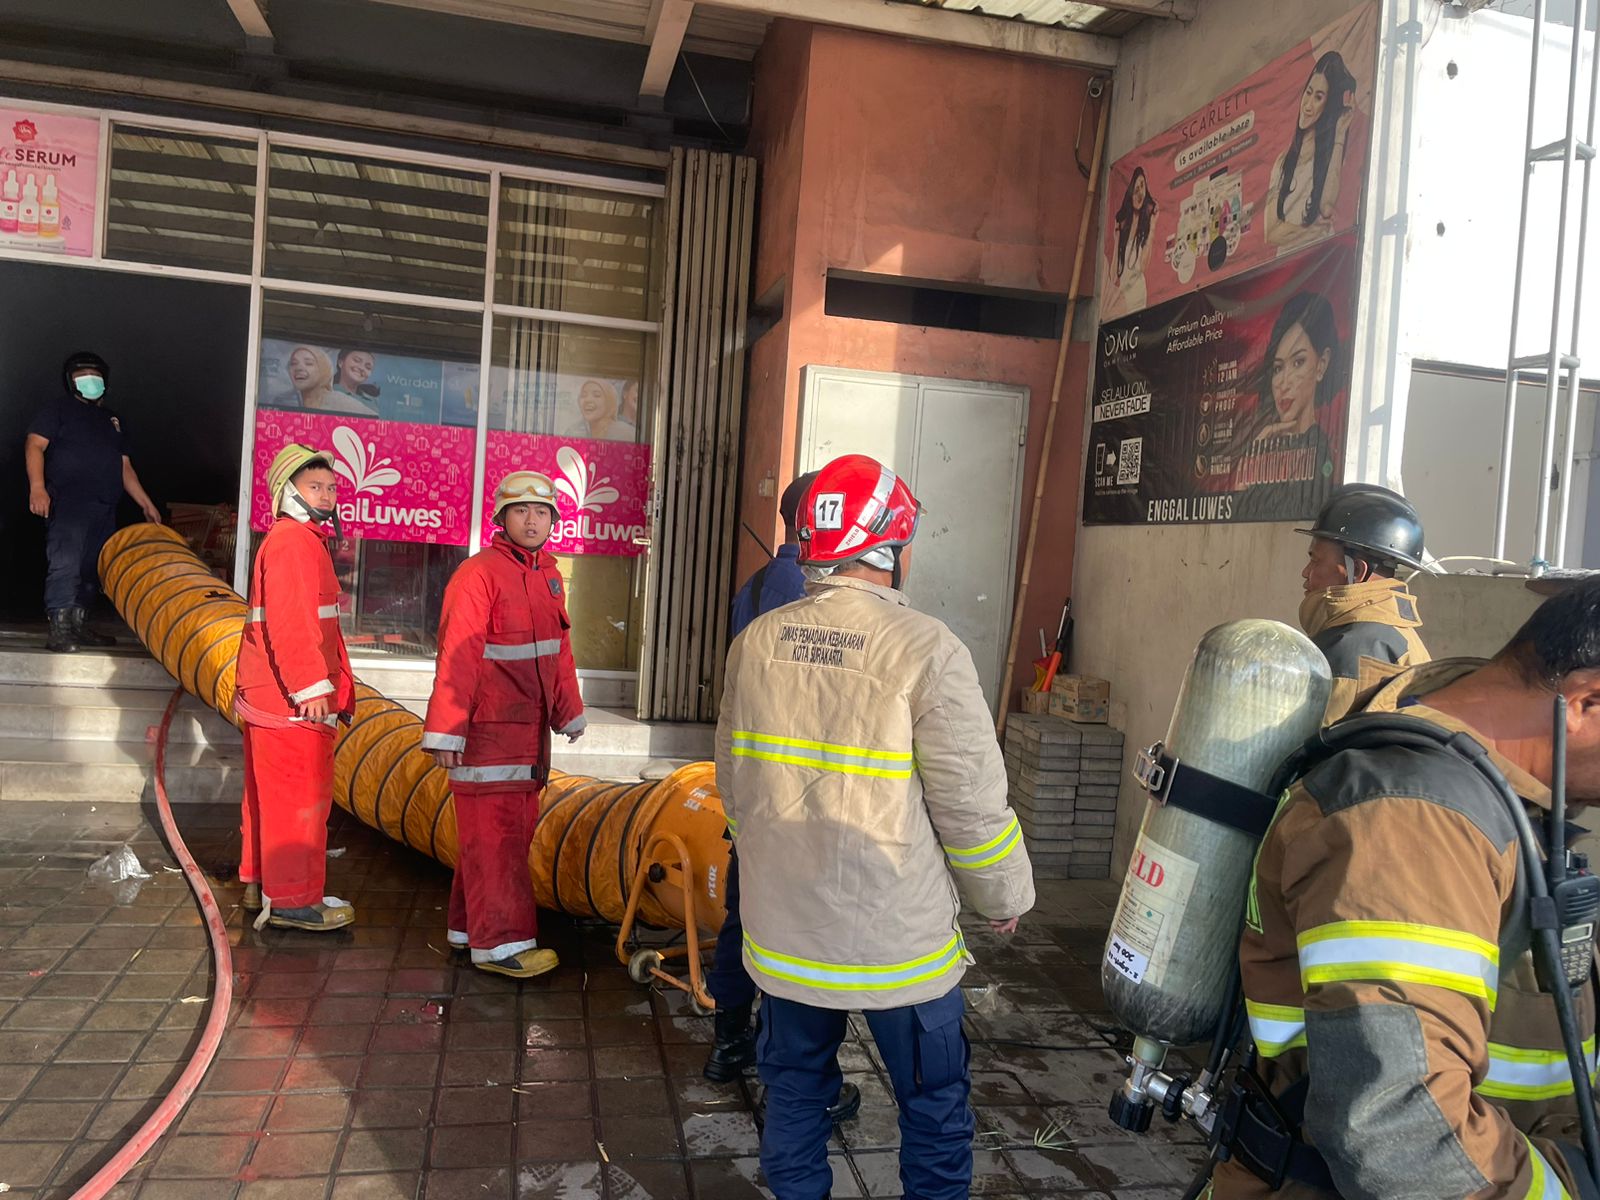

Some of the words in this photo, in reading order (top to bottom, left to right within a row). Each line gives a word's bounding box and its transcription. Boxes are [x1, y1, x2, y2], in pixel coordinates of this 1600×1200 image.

[1181, 90, 1249, 141] SCARLETT
[15, 148, 76, 167] SERUM
[1188, 132, 1227, 160] available
[1167, 321, 1199, 338] Premium
[1200, 309, 1224, 328] Quality
[1104, 326, 1139, 356] OMG
[1166, 333, 1204, 354] Affordable
[1204, 328, 1223, 342] Price
[386, 373, 439, 389] Wardah
[1101, 383, 1130, 403] SELALU
[1100, 401, 1125, 419] NEVER
[1126, 396, 1147, 415] FADE
[322, 498, 442, 528] alLuwes
[818, 500, 839, 522] 17
[1147, 498, 1189, 521] ENGGAL
[1192, 495, 1233, 520] LUWES
[780, 626, 798, 641] DINAS
[799, 627, 828, 645] PEMADAM
[828, 631, 867, 651] KEBAKARAN
[792, 644, 809, 662] KOTA
[809, 646, 843, 666] SURAKARTA
